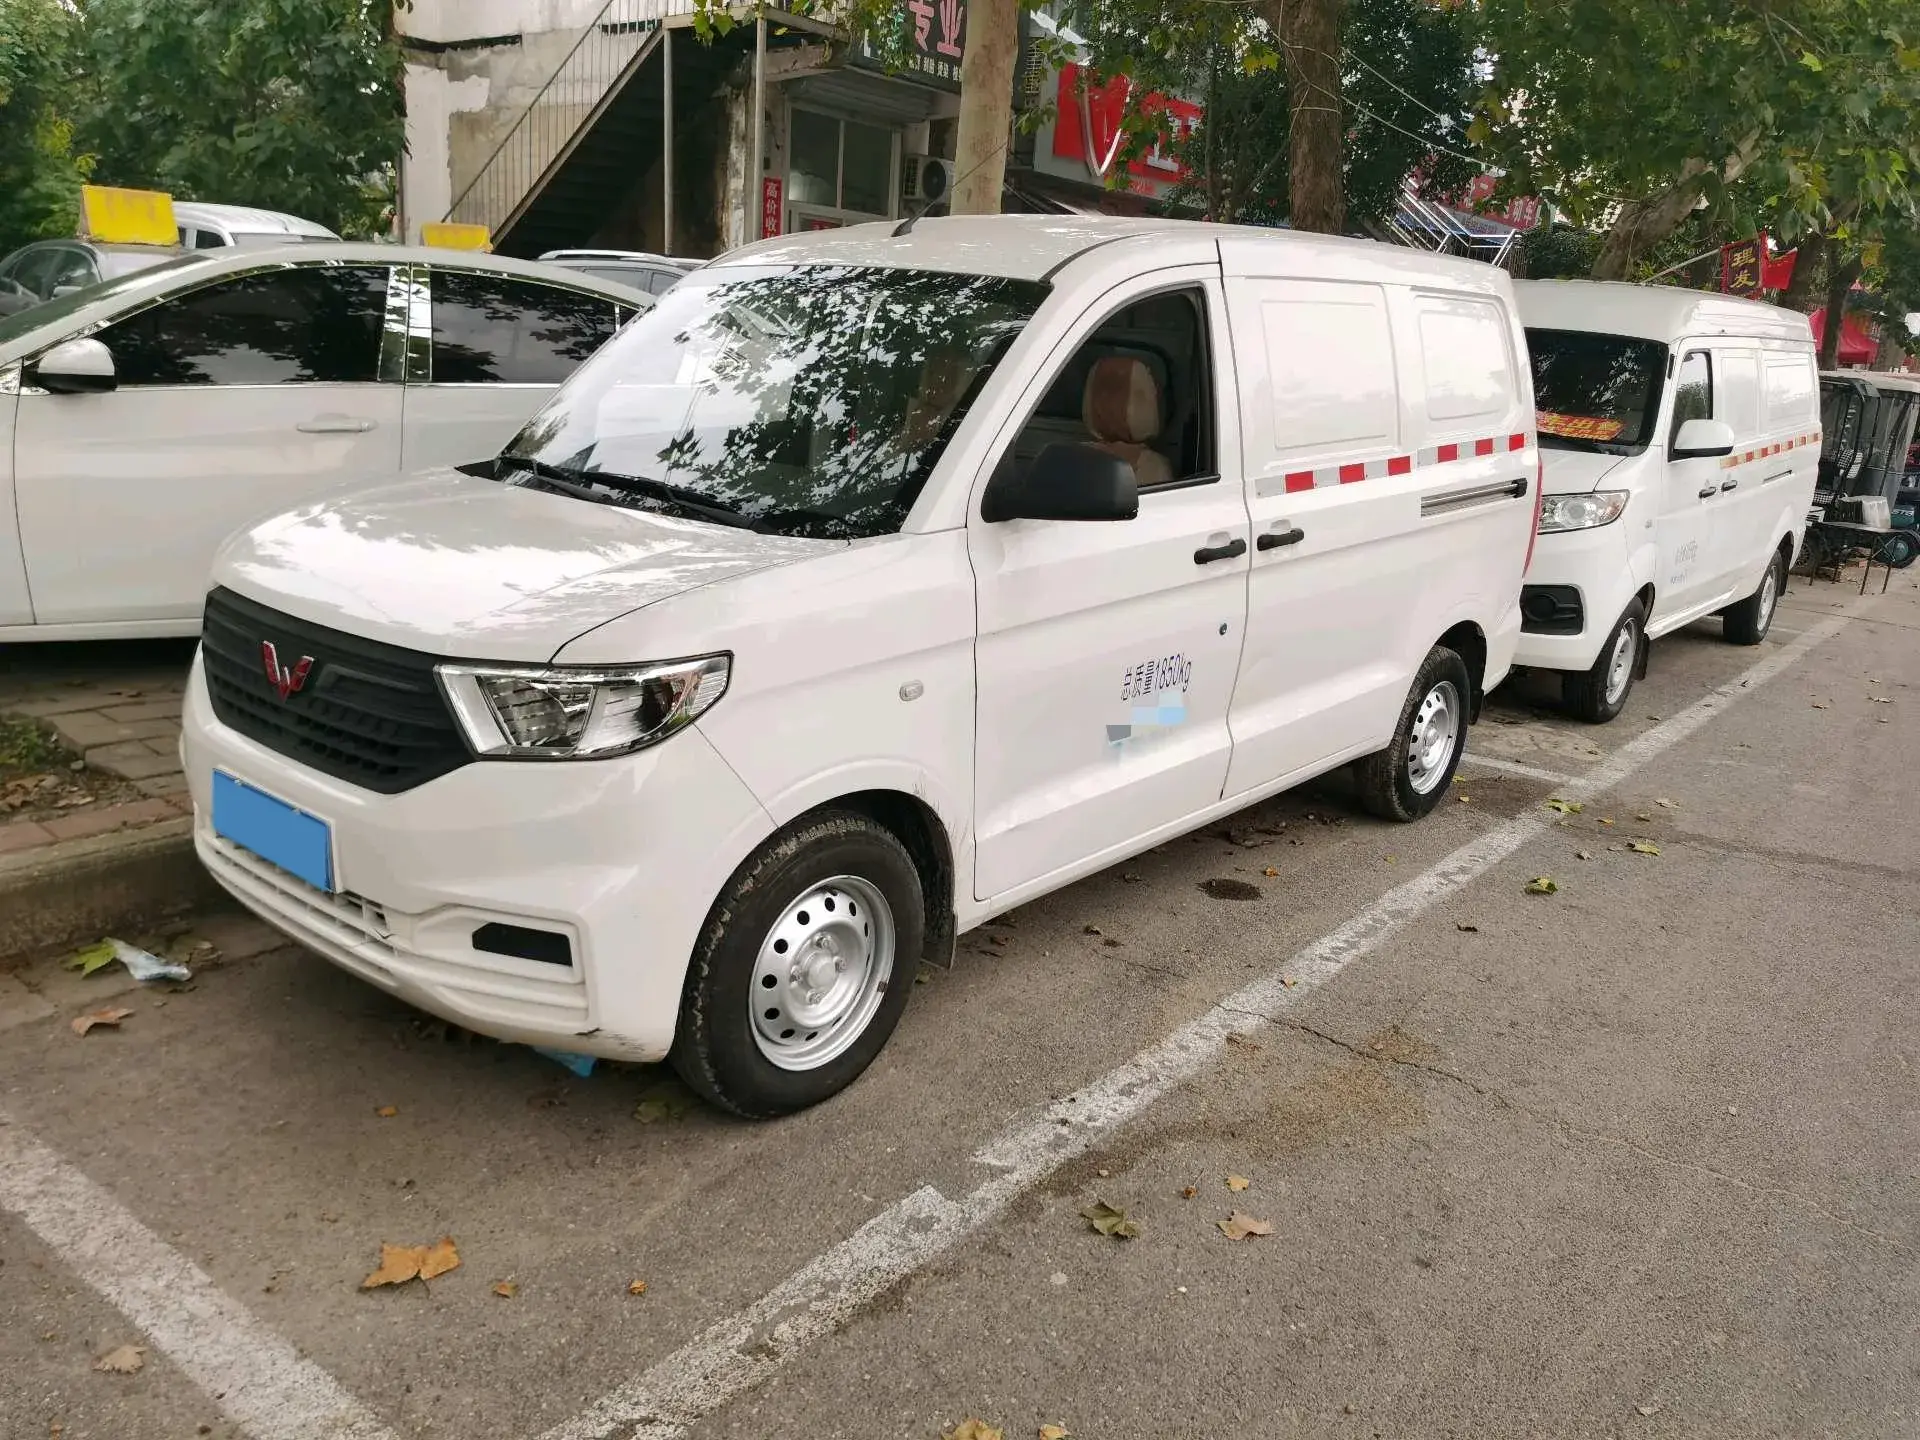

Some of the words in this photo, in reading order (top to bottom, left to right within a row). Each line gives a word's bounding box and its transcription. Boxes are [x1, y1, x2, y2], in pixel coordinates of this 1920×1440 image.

[908, 0, 963, 58] 专业
[1730, 247, 1756, 288] 理发
[1120, 653, 1192, 701] 总质量1850kg
